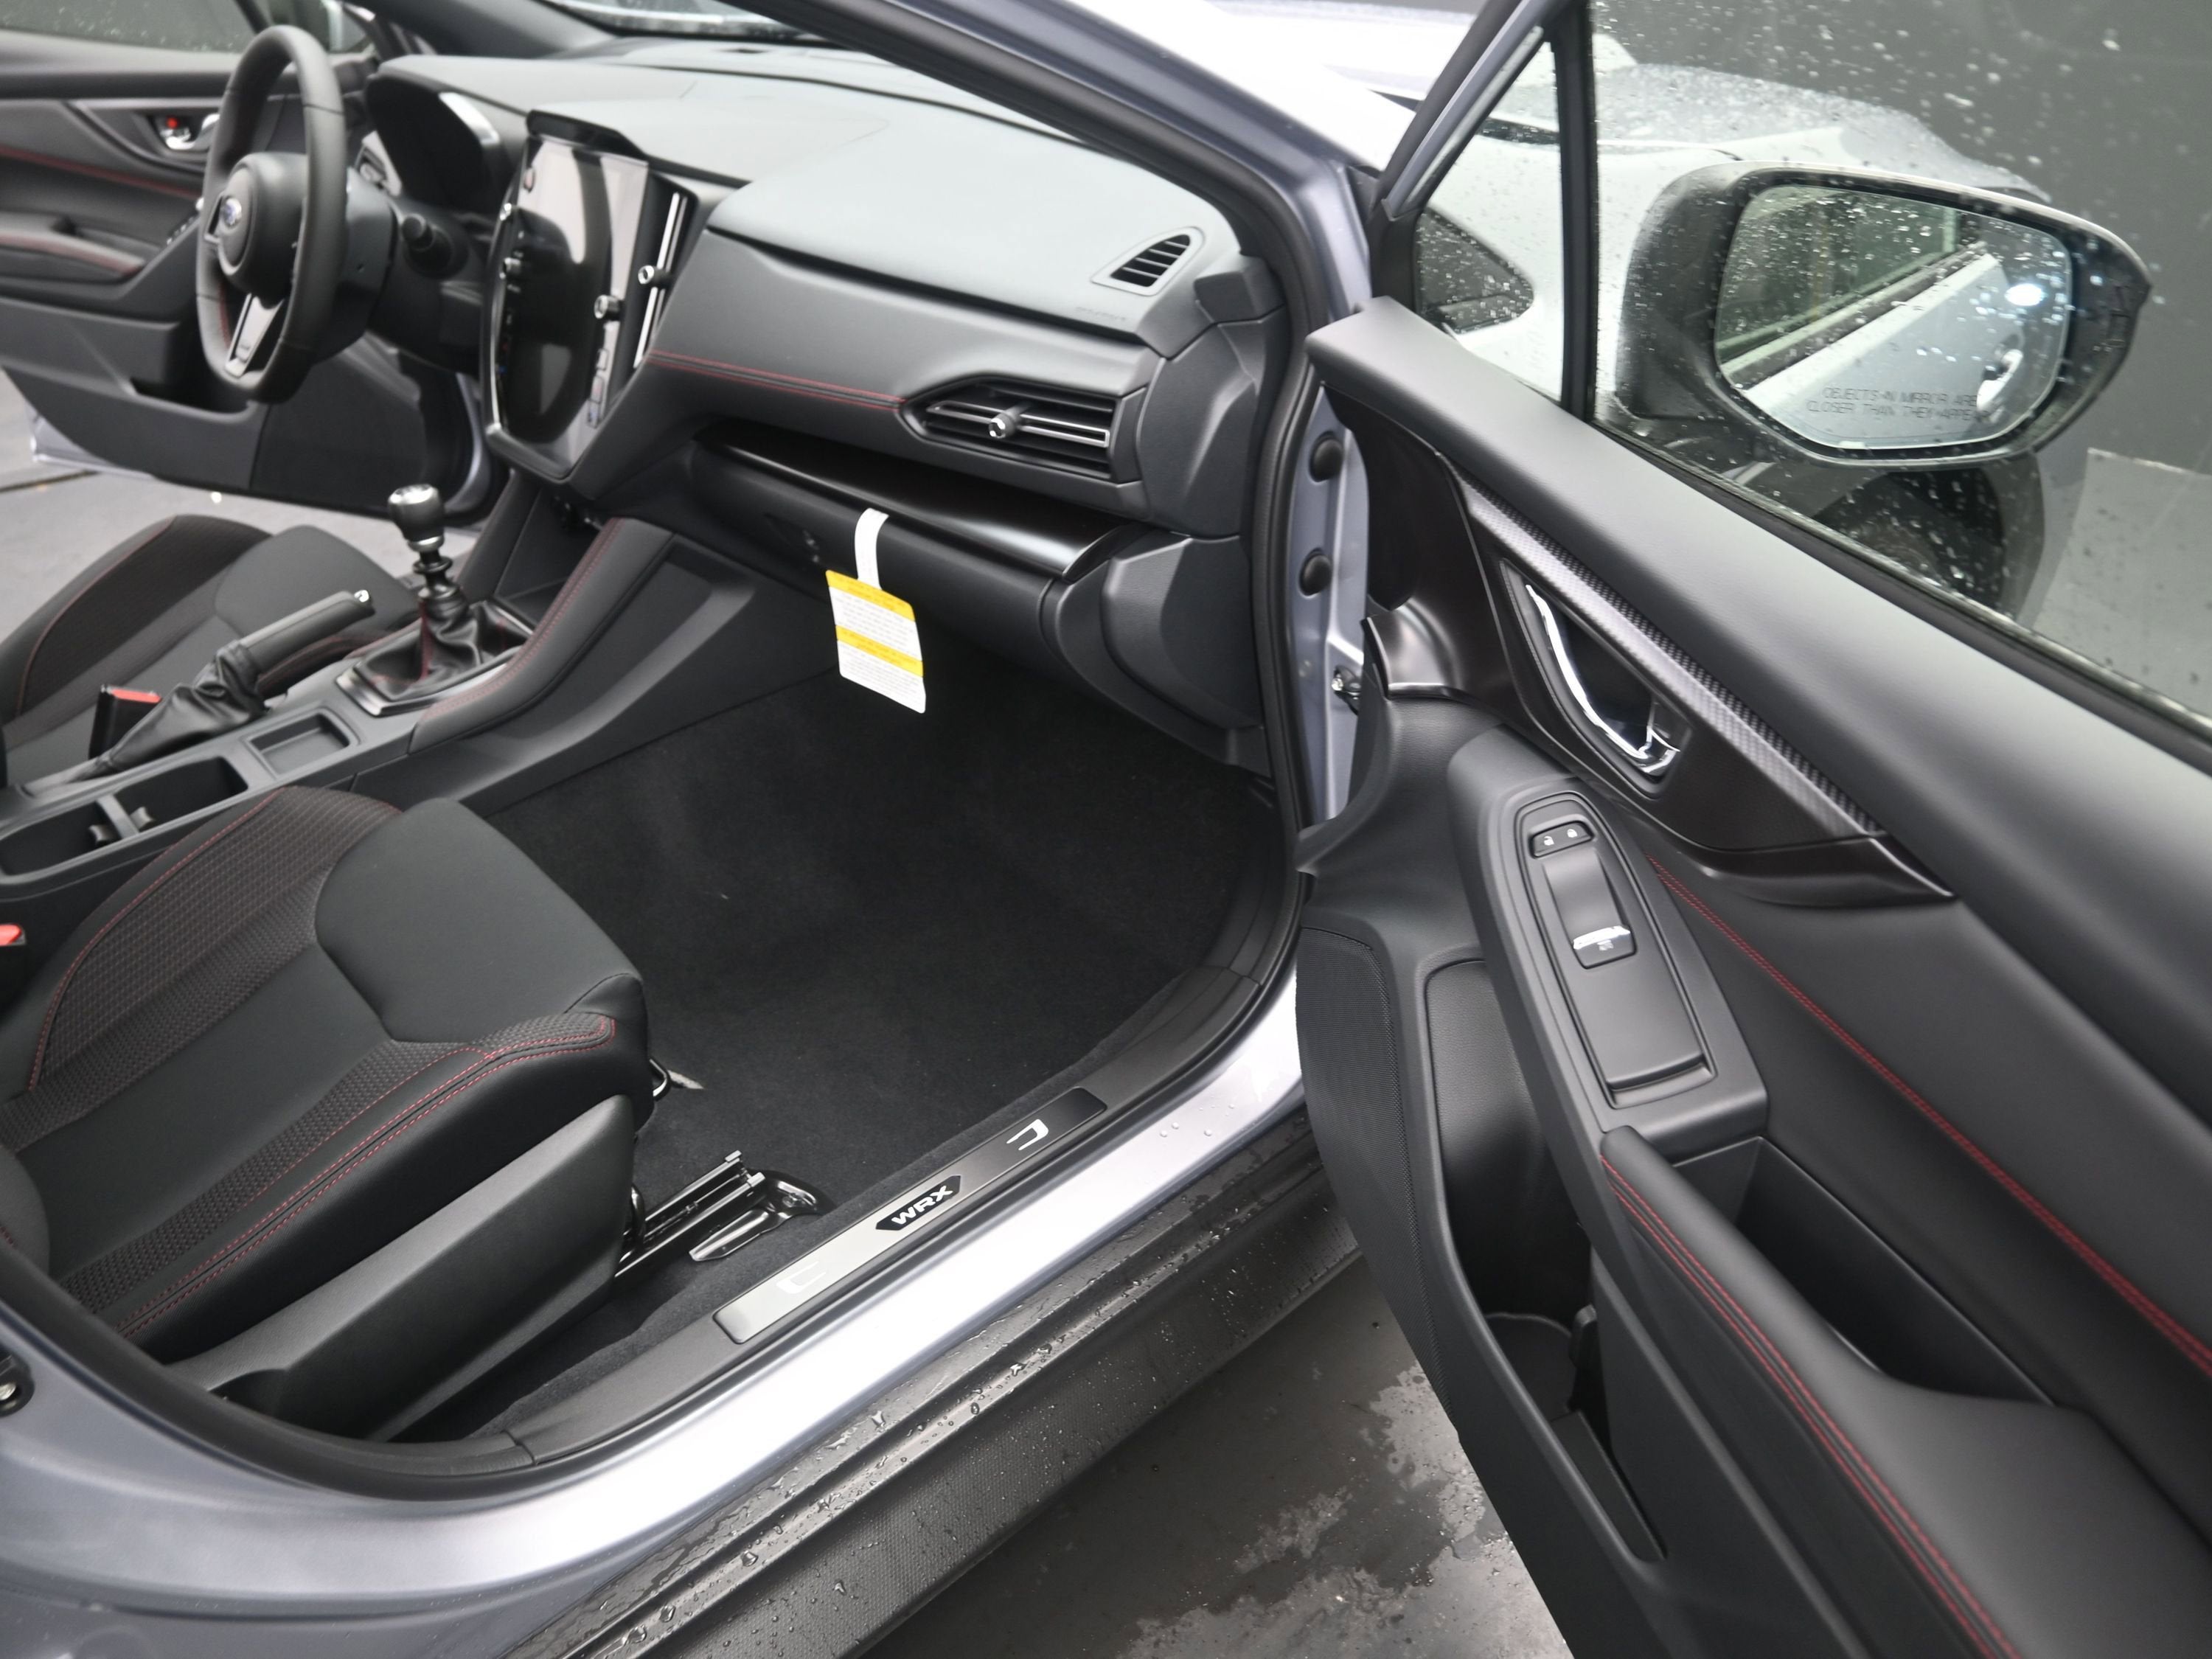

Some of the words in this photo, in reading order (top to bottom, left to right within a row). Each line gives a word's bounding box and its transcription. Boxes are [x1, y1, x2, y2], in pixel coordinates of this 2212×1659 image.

[1821, 386, 1879, 402] OBJECTS
[1900, 391, 1948, 405] MIRROR
[1954, 394, 1979, 407] ARE
[1806, 400, 1854, 414] CLOSER
[1863, 403, 1895, 416] THAN
[891, 1186, 953, 1225] WRX
